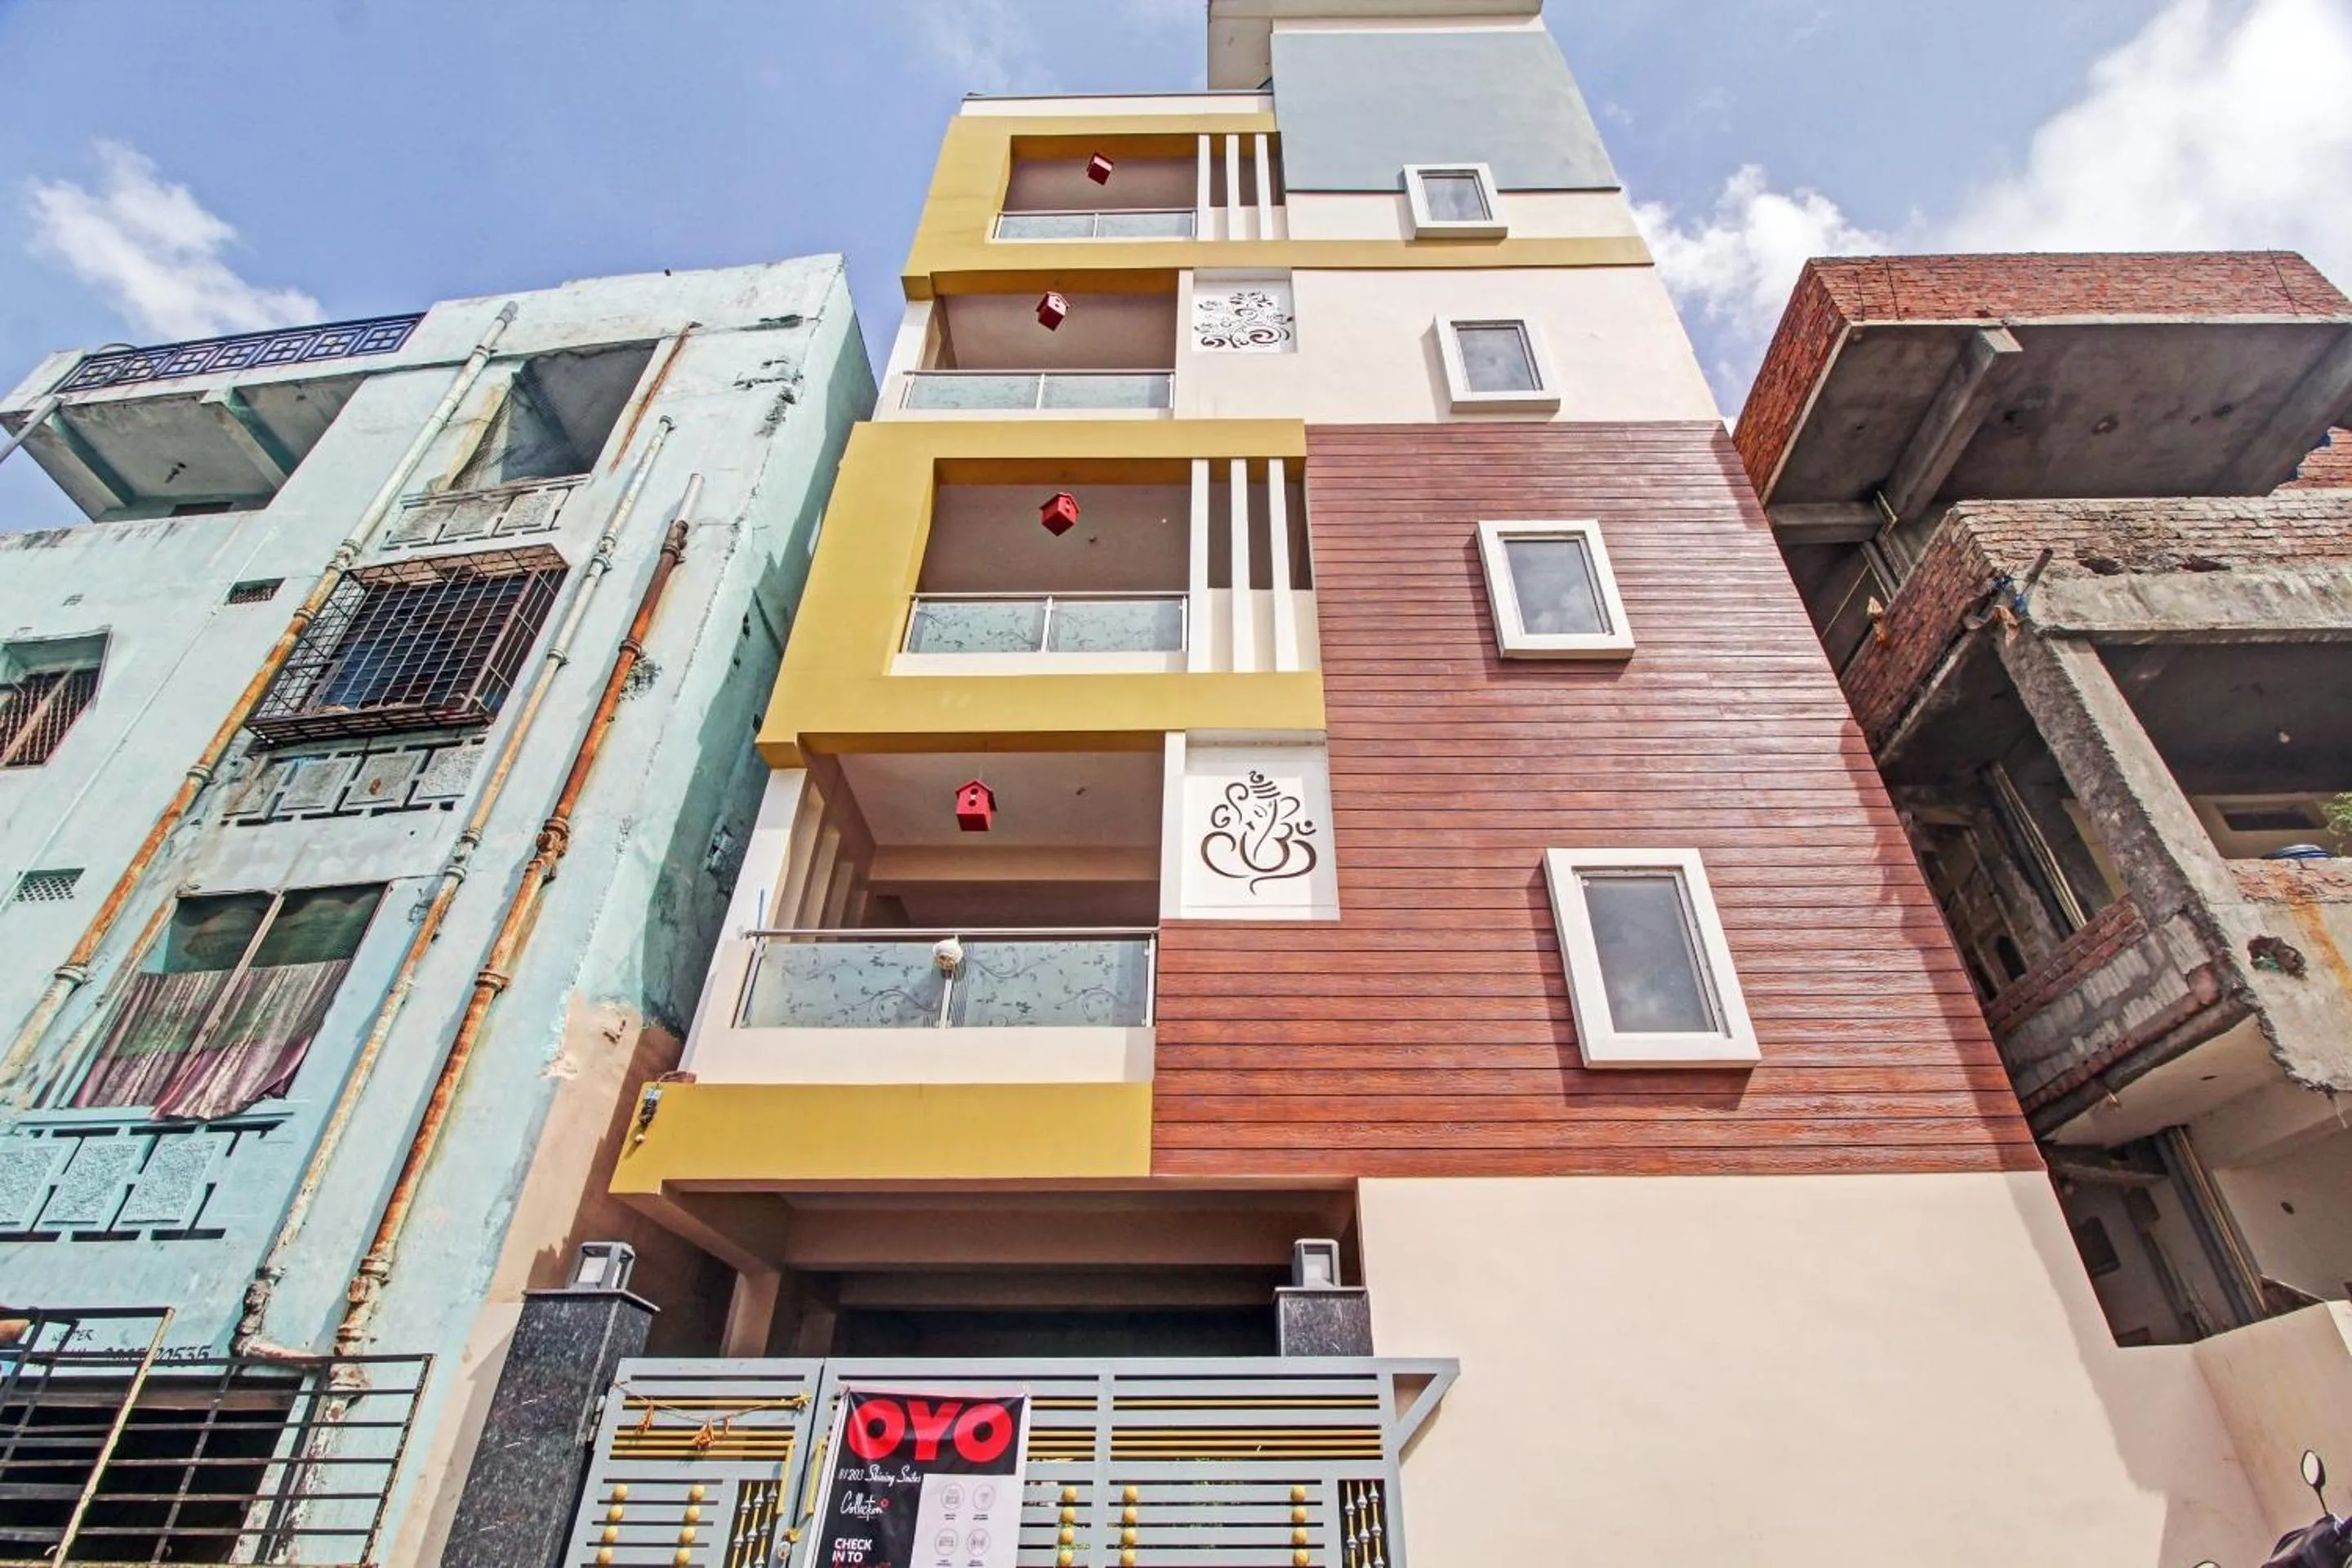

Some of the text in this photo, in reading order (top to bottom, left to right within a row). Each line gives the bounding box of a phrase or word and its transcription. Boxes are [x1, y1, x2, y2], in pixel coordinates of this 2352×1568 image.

[848, 1399, 1013, 1463] OYO
[864, 1463, 895, 1487] Shining
[840, 1490, 883, 1521] Collection
[835, 1537, 872, 1551] CHECK
[832, 1550, 863, 1563] IN TO
